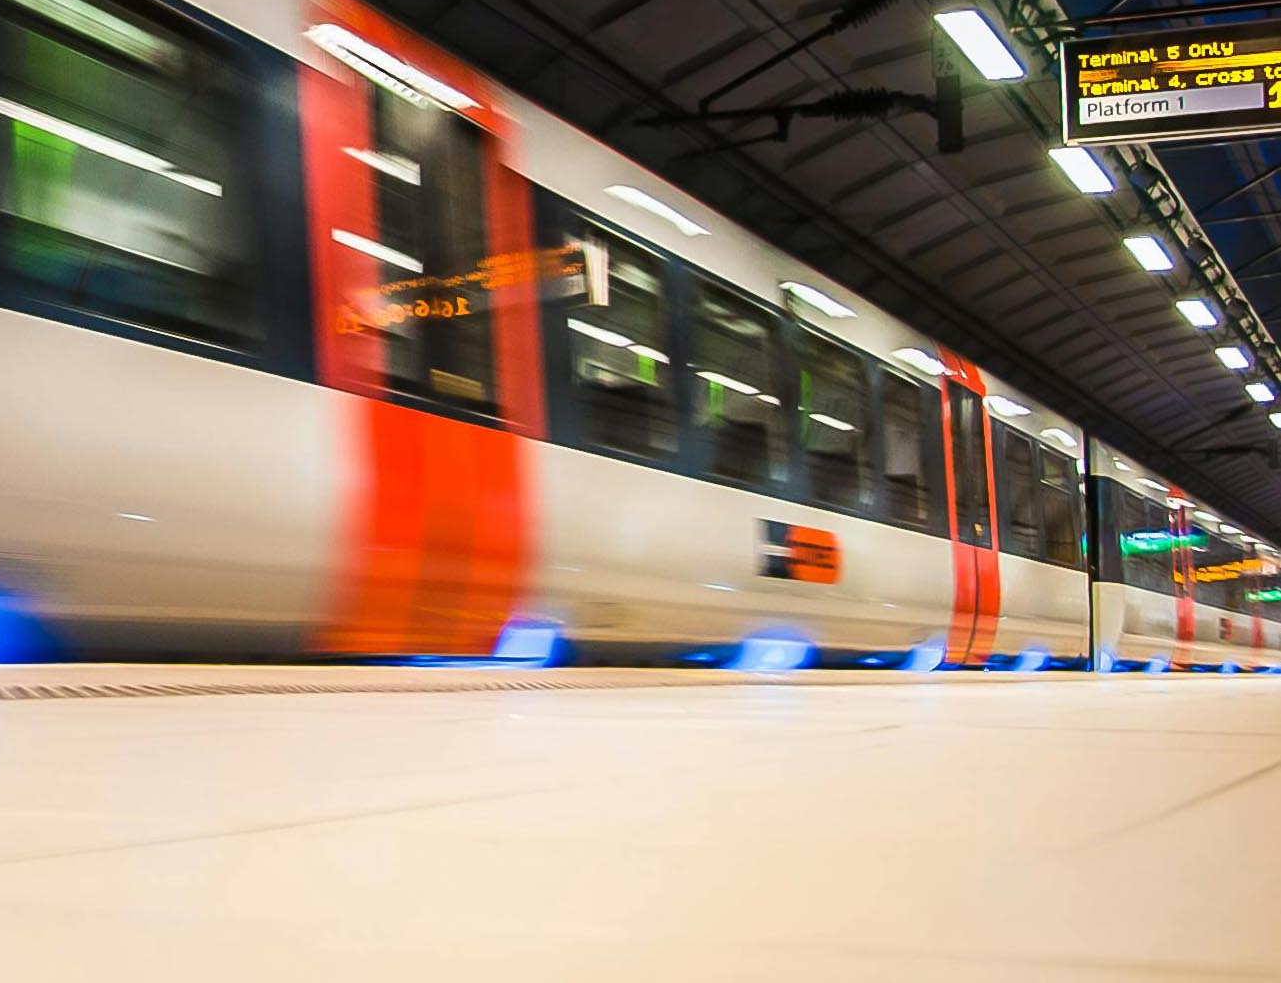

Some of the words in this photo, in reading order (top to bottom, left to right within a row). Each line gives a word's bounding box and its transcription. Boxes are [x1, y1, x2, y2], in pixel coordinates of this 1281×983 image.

[1078, 47, 1158, 68] Terminal
[1167, 45, 1180, 59] 5
[1189, 42, 1234, 58] Only
[1079, 76, 1159, 96] Terminal
[1195, 69, 1255, 86] cross
[1087, 99, 1169, 117] Platform
[1177, 96, 1184, 110] 1
